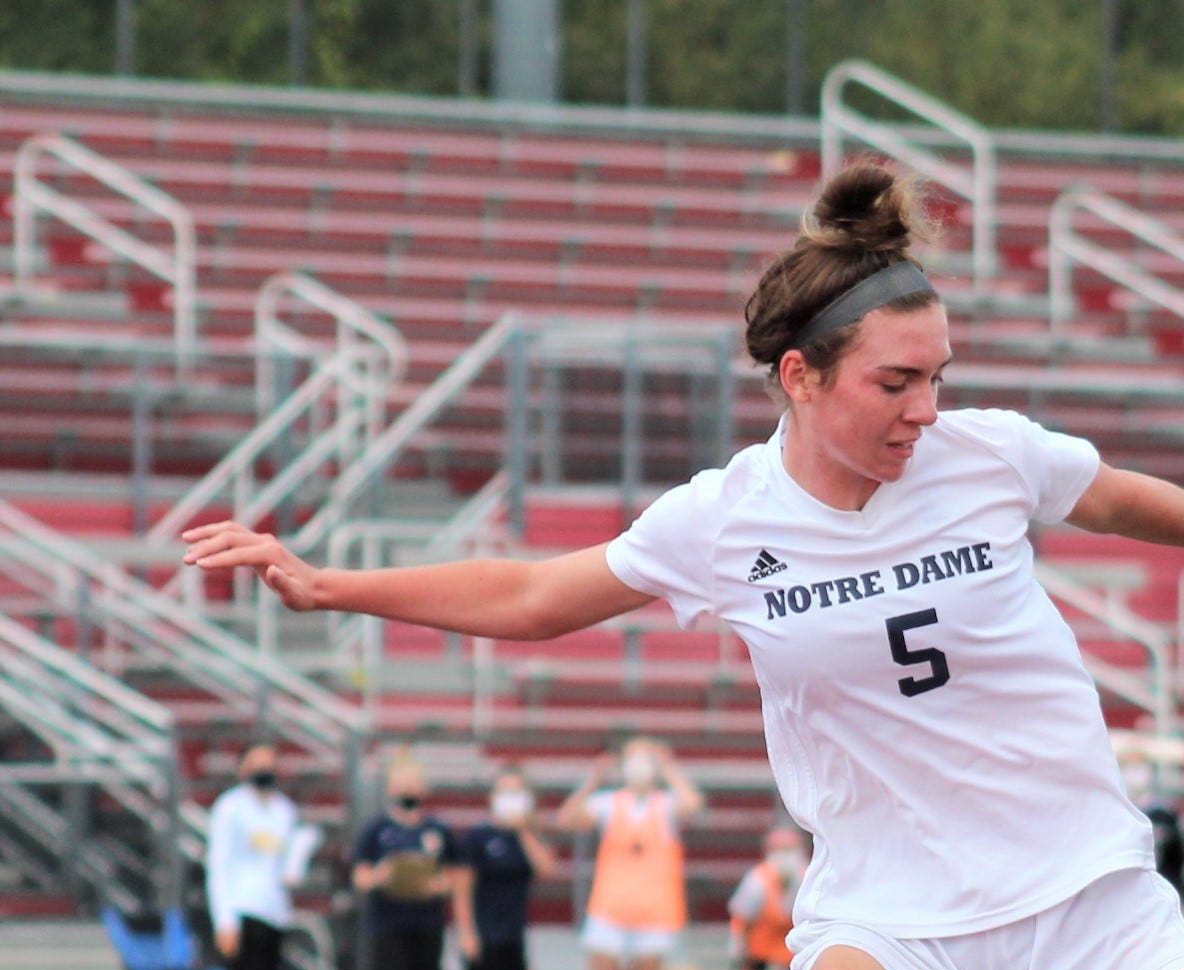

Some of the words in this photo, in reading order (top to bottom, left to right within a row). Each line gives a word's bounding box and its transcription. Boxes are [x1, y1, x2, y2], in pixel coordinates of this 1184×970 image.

[748, 562, 788, 582] adidas
[763, 570, 884, 620] NOTRE
[892, 542, 993, 590] DAME
[885, 608, 950, 697] 5
